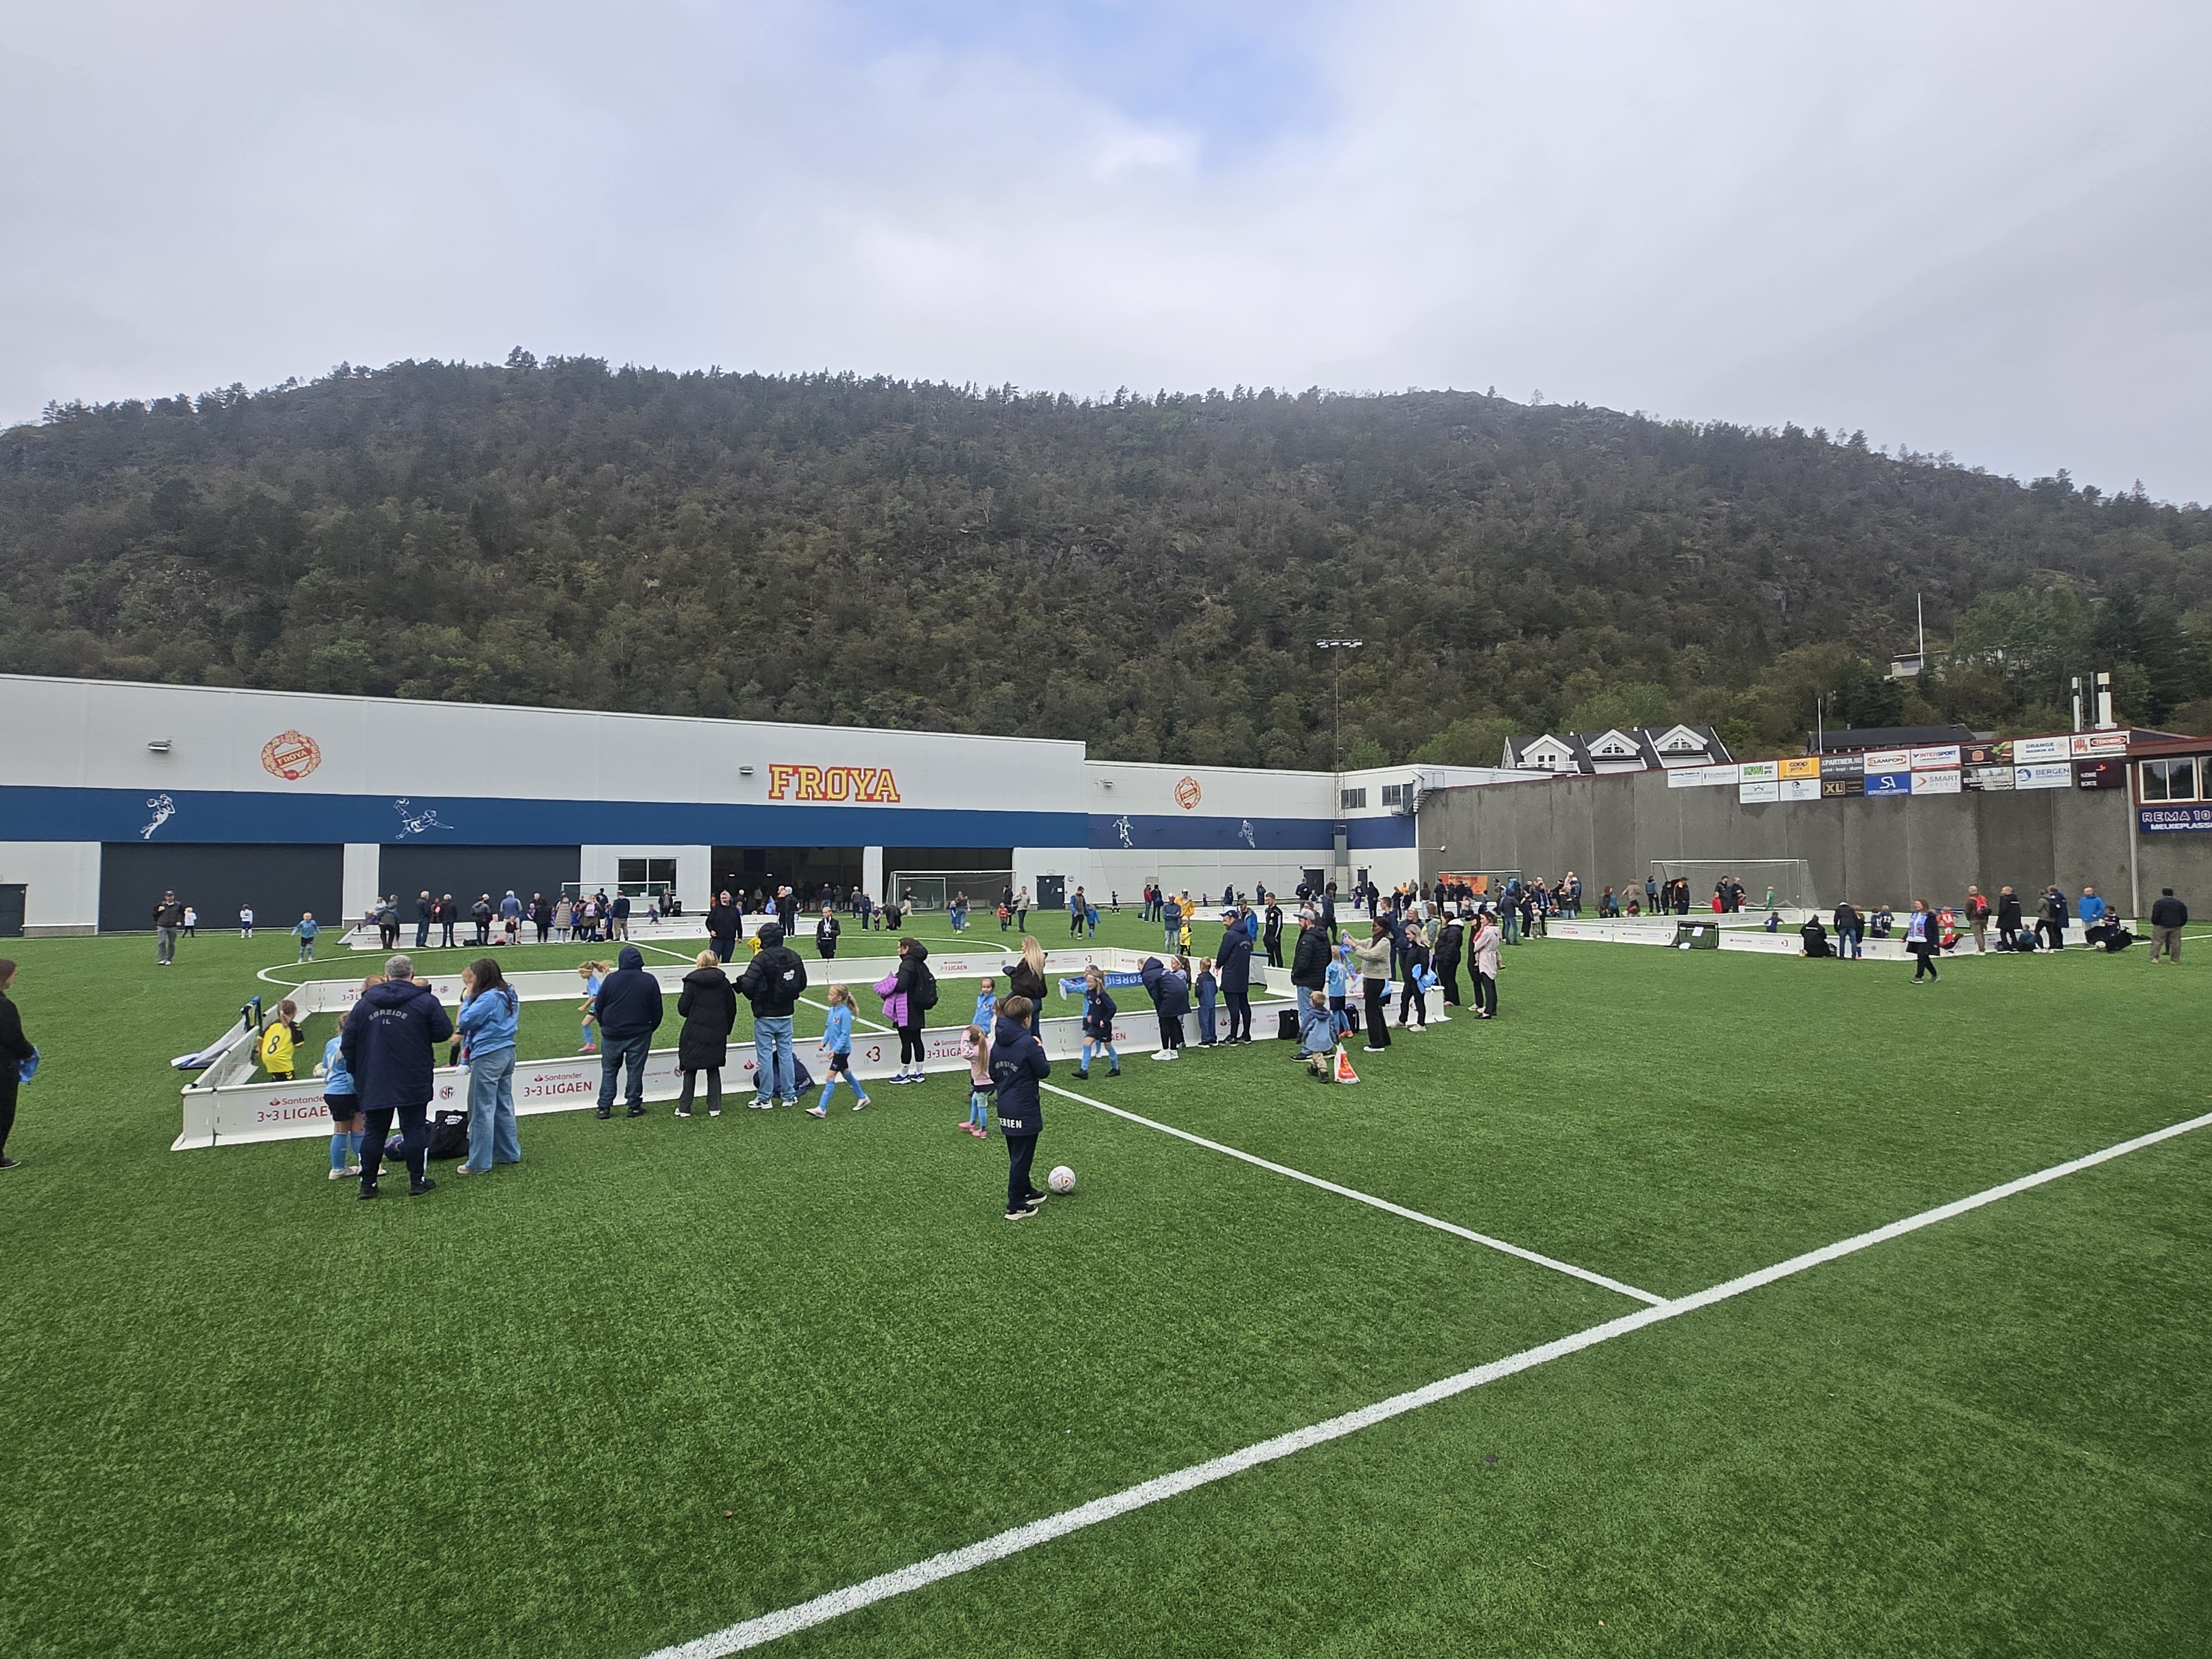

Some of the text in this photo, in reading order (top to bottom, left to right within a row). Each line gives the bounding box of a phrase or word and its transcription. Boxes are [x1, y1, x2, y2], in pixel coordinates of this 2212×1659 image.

[277, 750, 308, 764] FRØYA
[1821, 757, 1863, 766] XPARTNER.NO
[1744, 765, 1764, 775] KIWI
[769, 764, 900, 803] FRØYA
[2142, 810, 2212, 822] REMA 10
[2150, 822, 2212, 830] MELKEPLASS
[368, 1009, 408, 1021] SØREIDE
[268, 1035, 280, 1055] 8
[942, 1047, 962, 1057] LIGA
[995, 1061, 1019, 1072] ØREIDE
[544, 1072, 582, 1082] Santander
[546, 1081, 592, 1095] LIGAEN
[282, 1095, 325, 1105] Santande
[283, 1105, 328, 1120] LIGAE
[998, 1117, 1022, 1129] ERSEN
